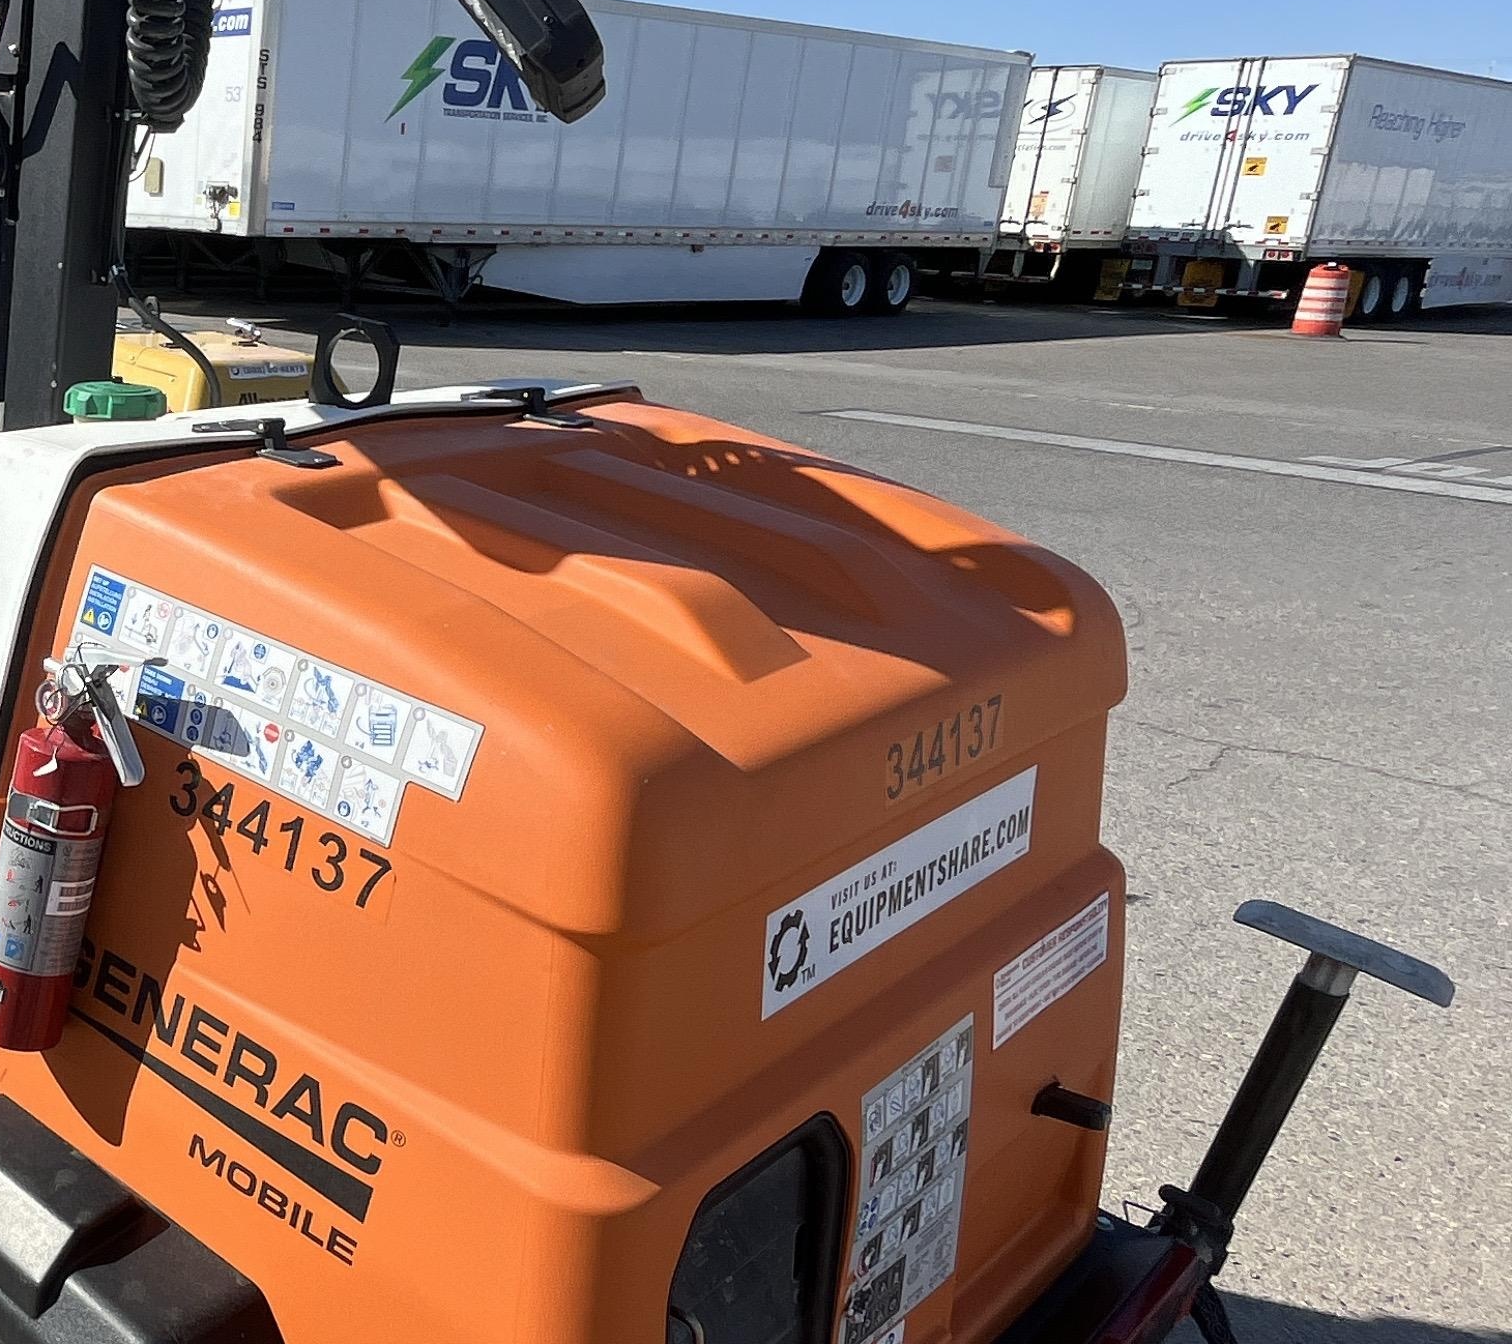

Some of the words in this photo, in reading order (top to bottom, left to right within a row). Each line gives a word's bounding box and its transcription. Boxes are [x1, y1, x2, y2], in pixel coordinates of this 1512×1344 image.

[443, 39, 550, 114] SK
[1209, 83, 1320, 117] SKY
[865, 198, 959, 220] drive4sky.com
[886, 693, 1003, 801] 344137
[168, 760, 394, 909] 344137
[827, 804, 1031, 956] EQUIPMENTSHARE.COM
[830, 880, 860, 911] VISIT
[863, 869, 878, 888] US
[881, 859, 899, 880] AT:
[187, 1133, 359, 1267] MOBILE
